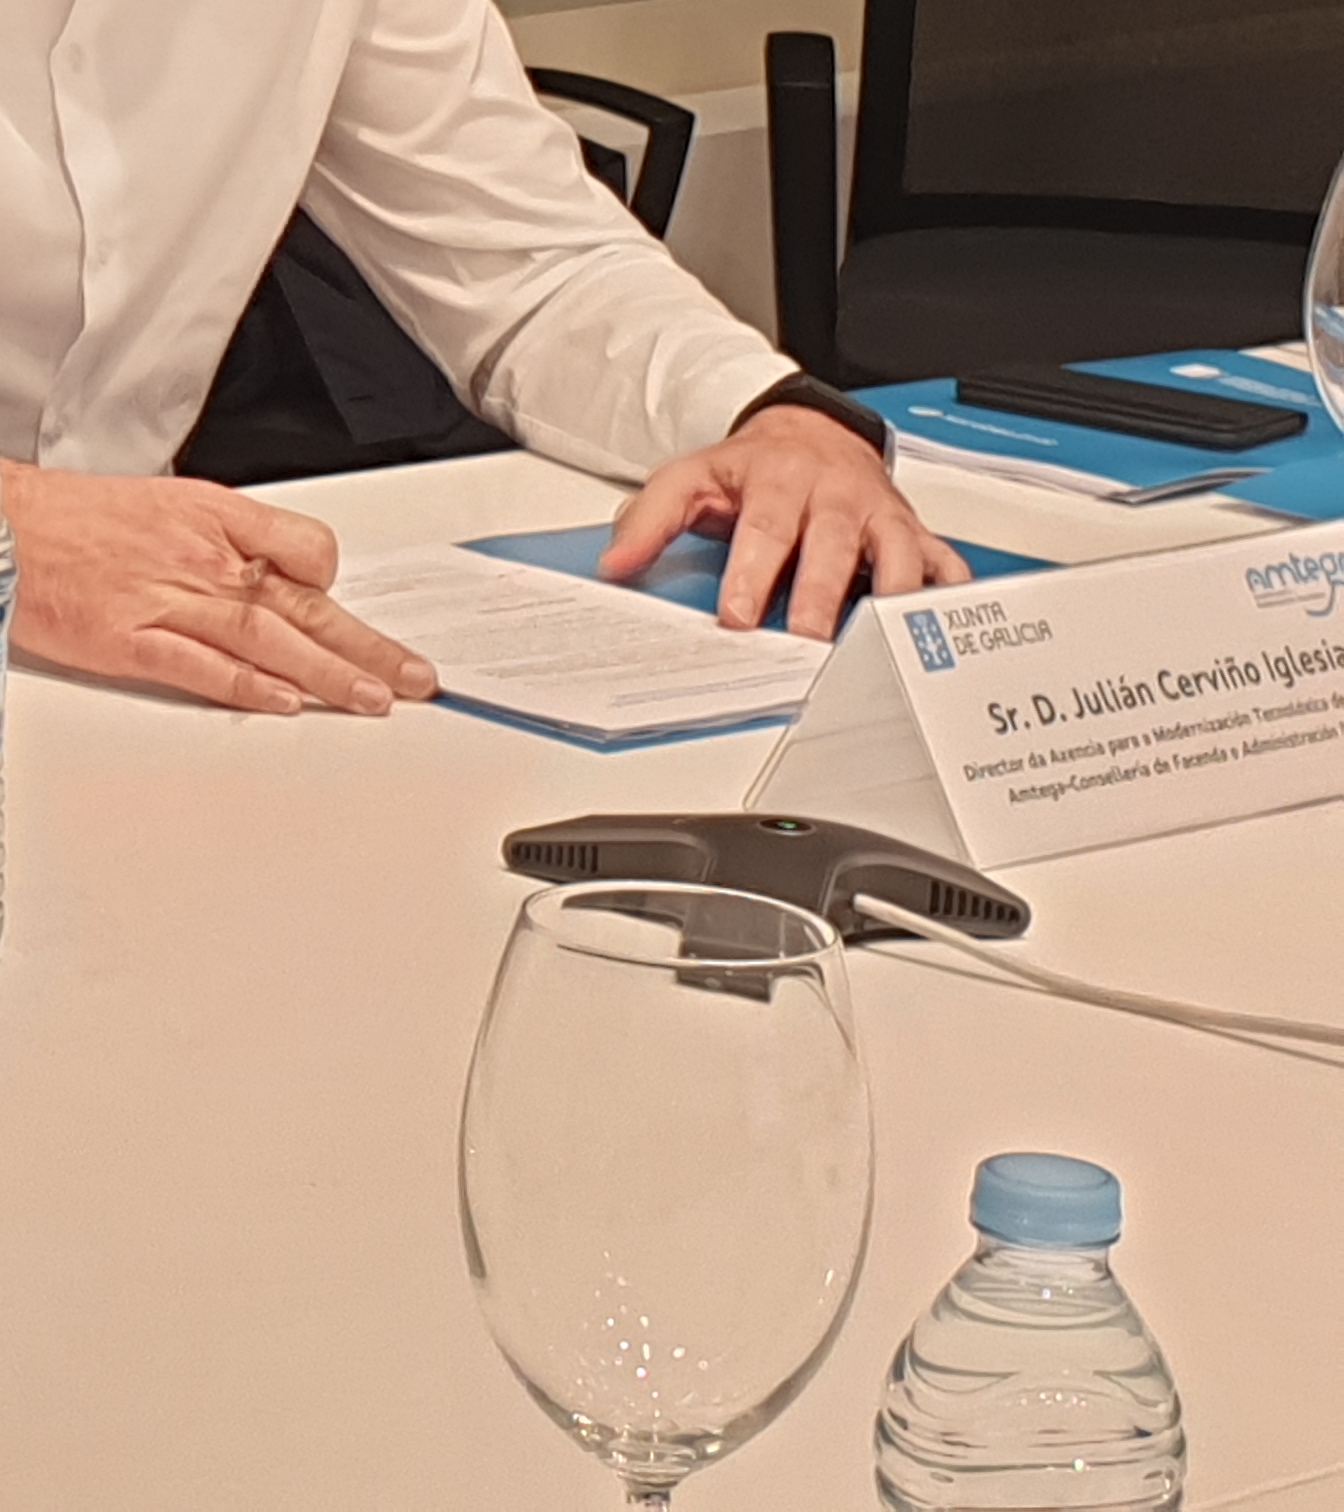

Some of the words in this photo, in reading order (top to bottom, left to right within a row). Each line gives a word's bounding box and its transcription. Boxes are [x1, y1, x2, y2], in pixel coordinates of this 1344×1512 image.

[943, 601, 1007, 629] XUNTA
[952, 632, 979, 655] DE
[979, 619, 1053, 651] GALICIA
[987, 702, 1030, 734] Sr.
[1031, 694, 1066, 725] D.
[1072, 675, 1155, 719] Julián
[1157, 656, 1260, 700] Cerviño
[962, 758, 1023, 781] Director
